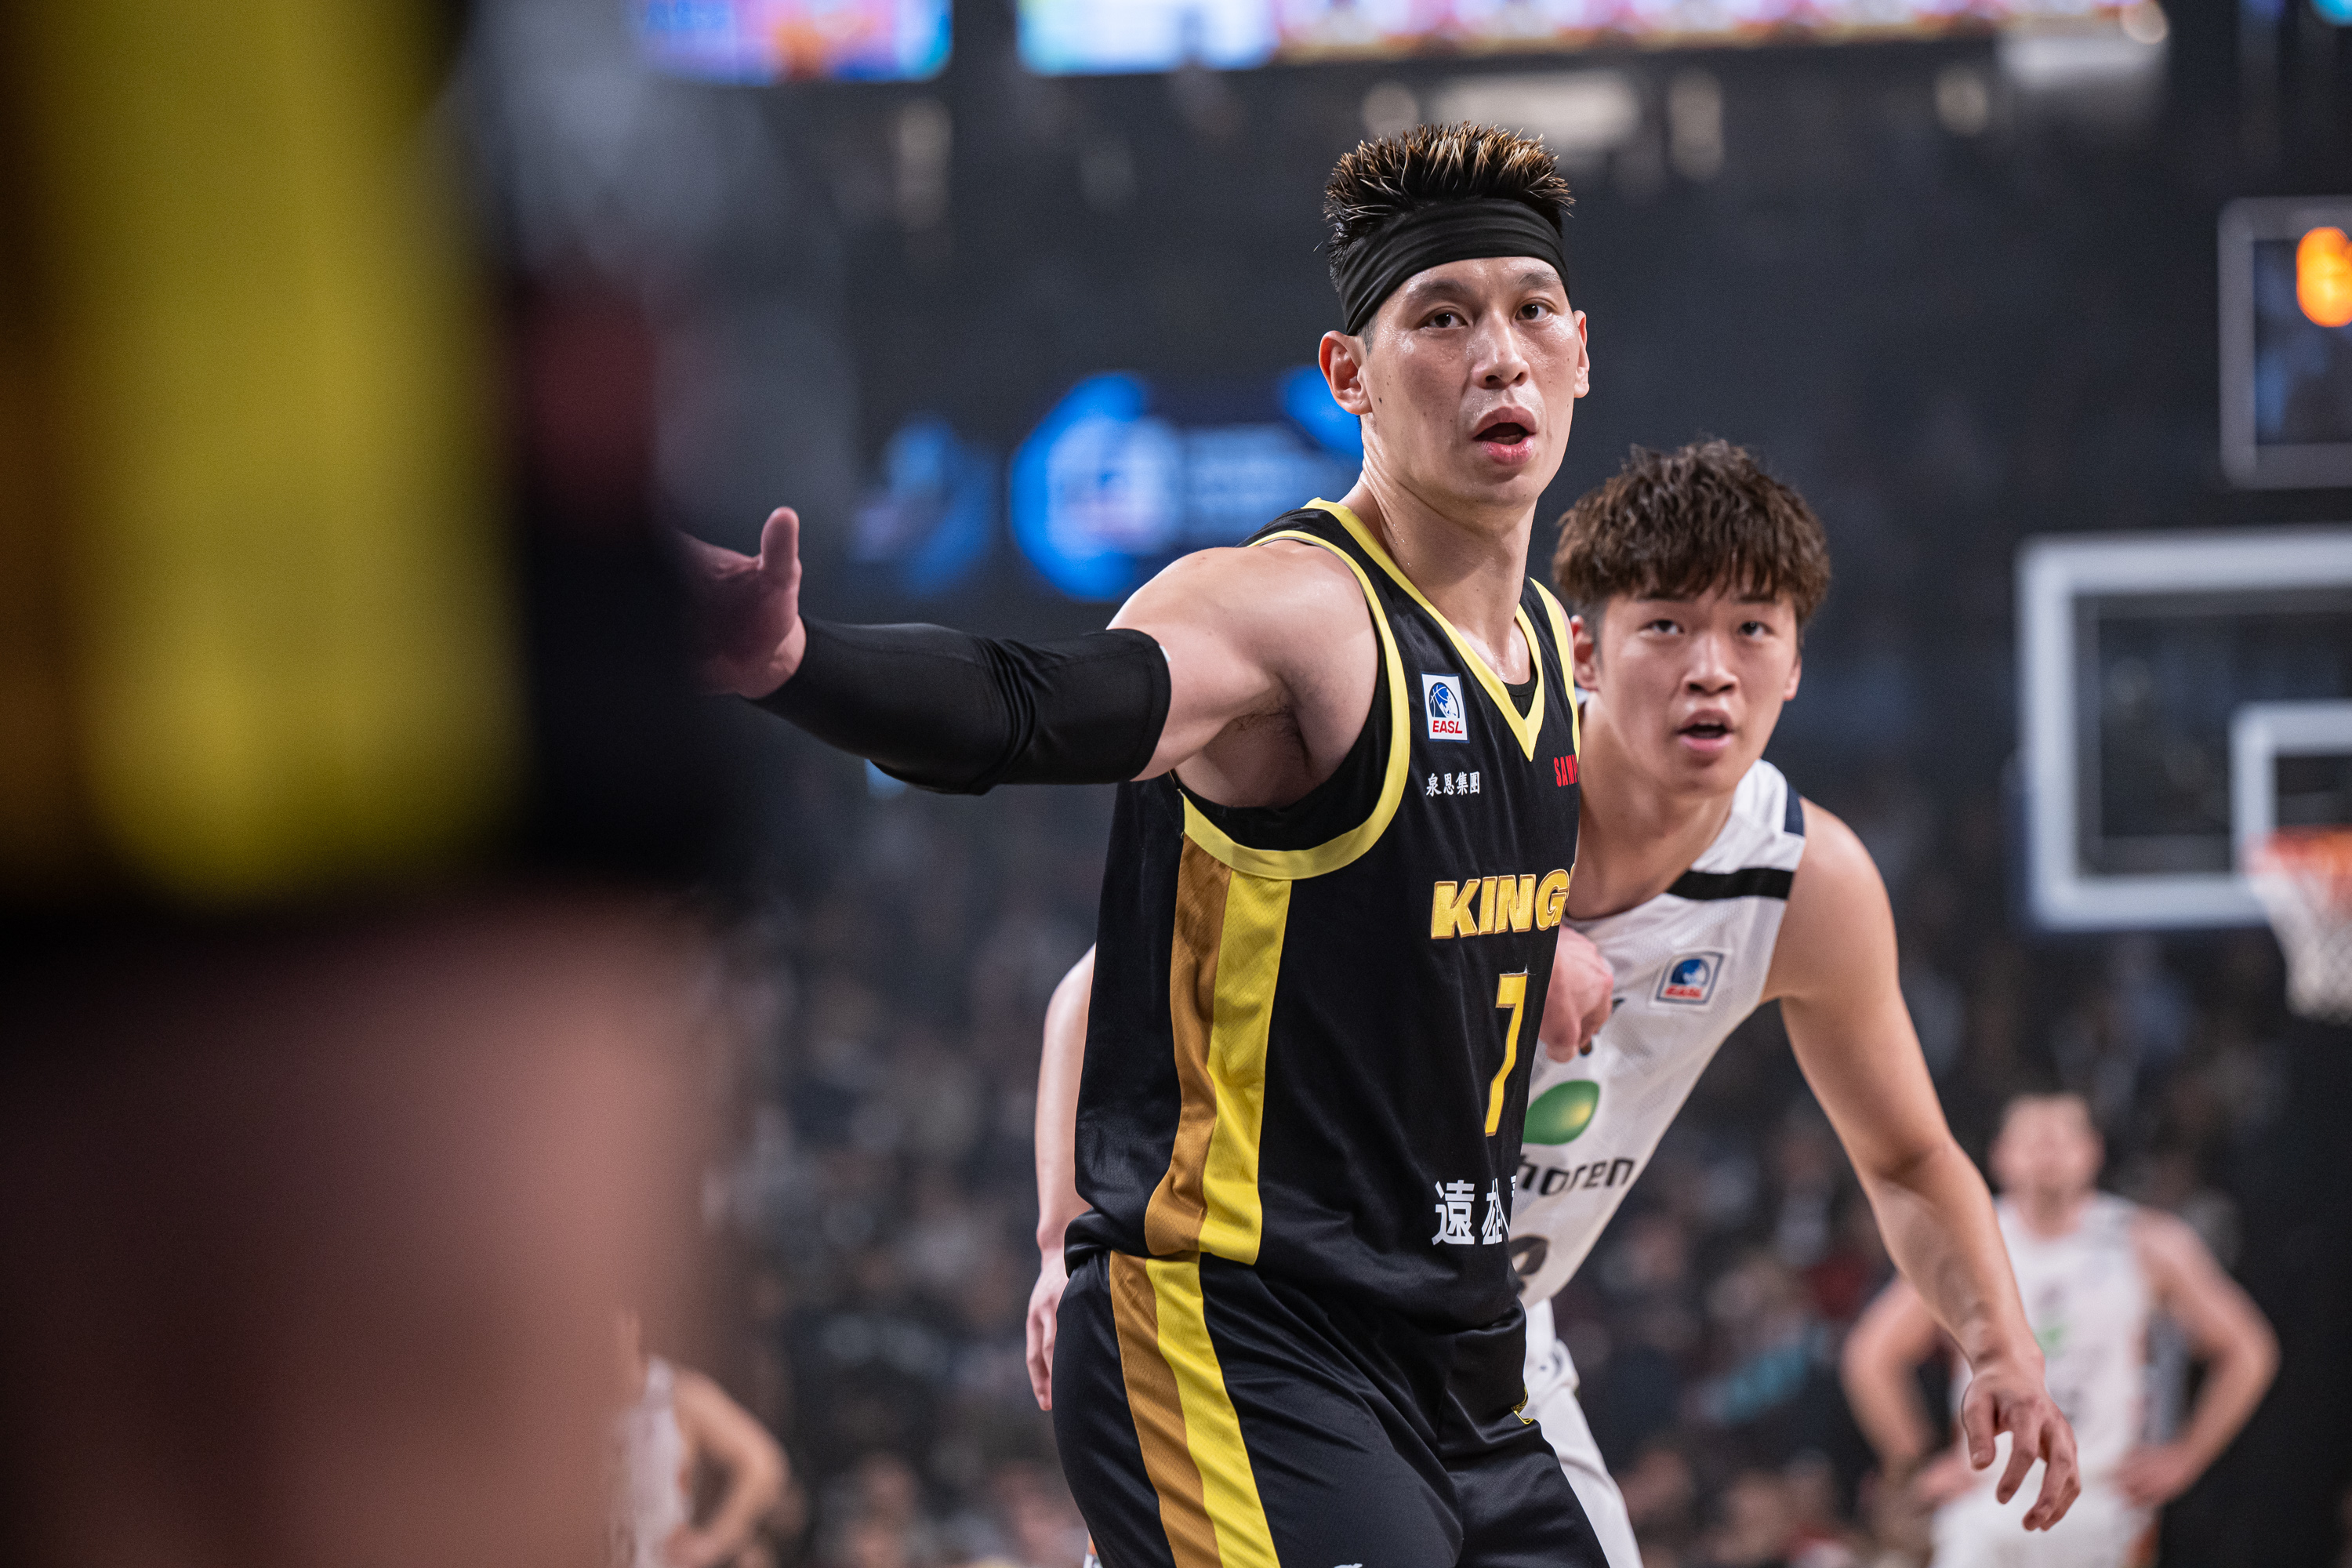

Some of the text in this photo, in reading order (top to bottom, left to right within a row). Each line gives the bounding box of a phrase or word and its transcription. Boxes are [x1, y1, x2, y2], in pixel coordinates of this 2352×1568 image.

[1432, 720, 1463, 734] EASL
[1553, 753, 1579, 787] SAMP
[1431, 862, 1576, 939] KING
[1484, 972, 1528, 1137] 7
[1431, 1175, 1517, 1246] 遠雄
